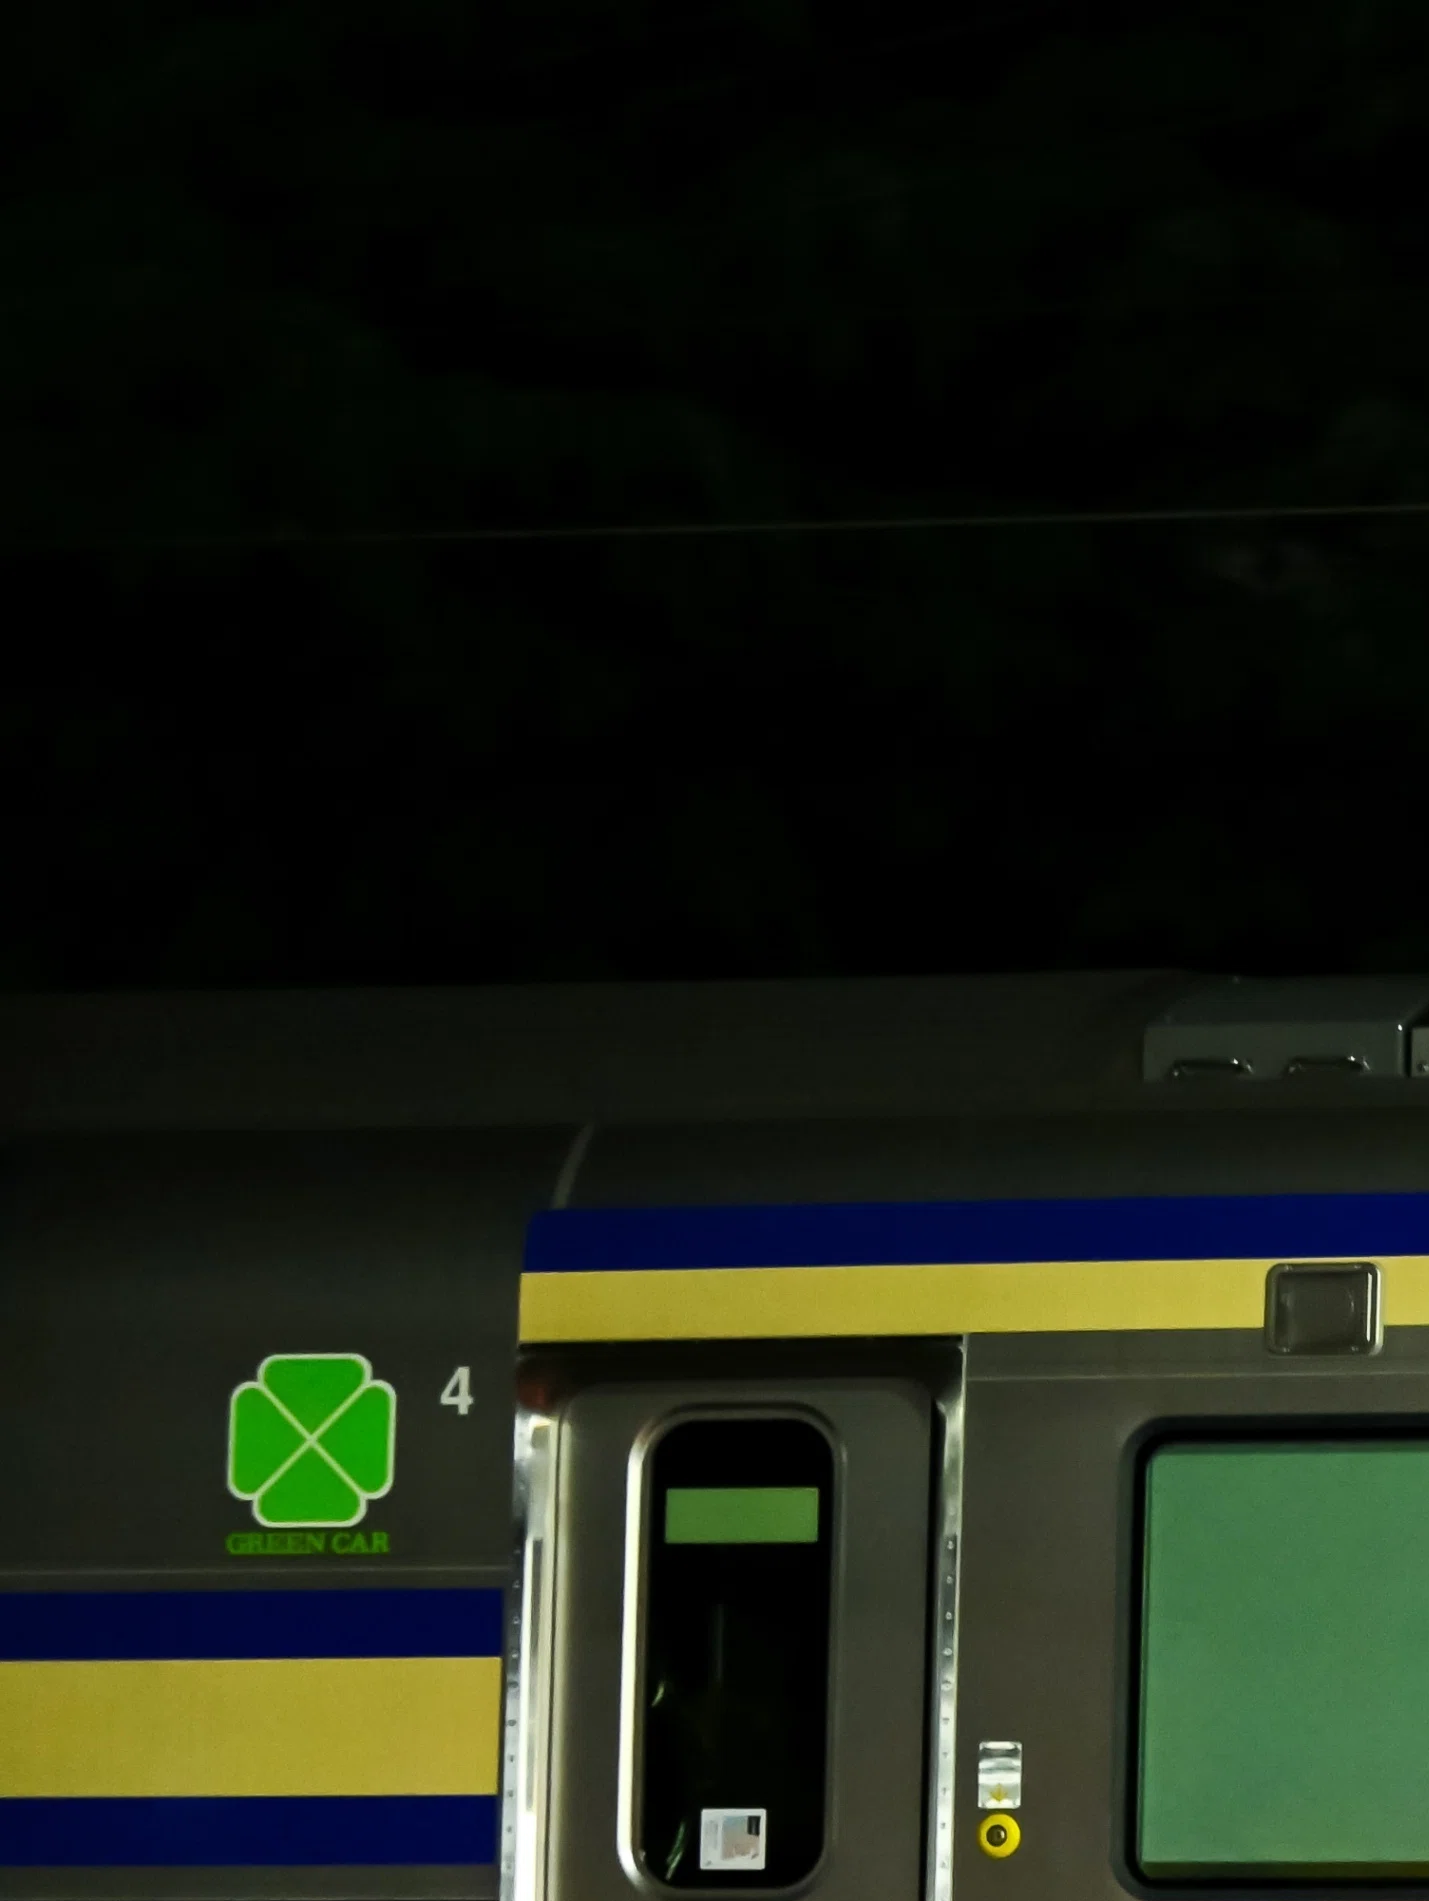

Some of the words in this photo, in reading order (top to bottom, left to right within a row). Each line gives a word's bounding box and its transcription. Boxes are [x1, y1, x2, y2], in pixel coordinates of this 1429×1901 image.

[439, 1366, 475, 1416] 4
[225, 1530, 327, 1555] GREEN
[331, 1531, 391, 1554] CAR
